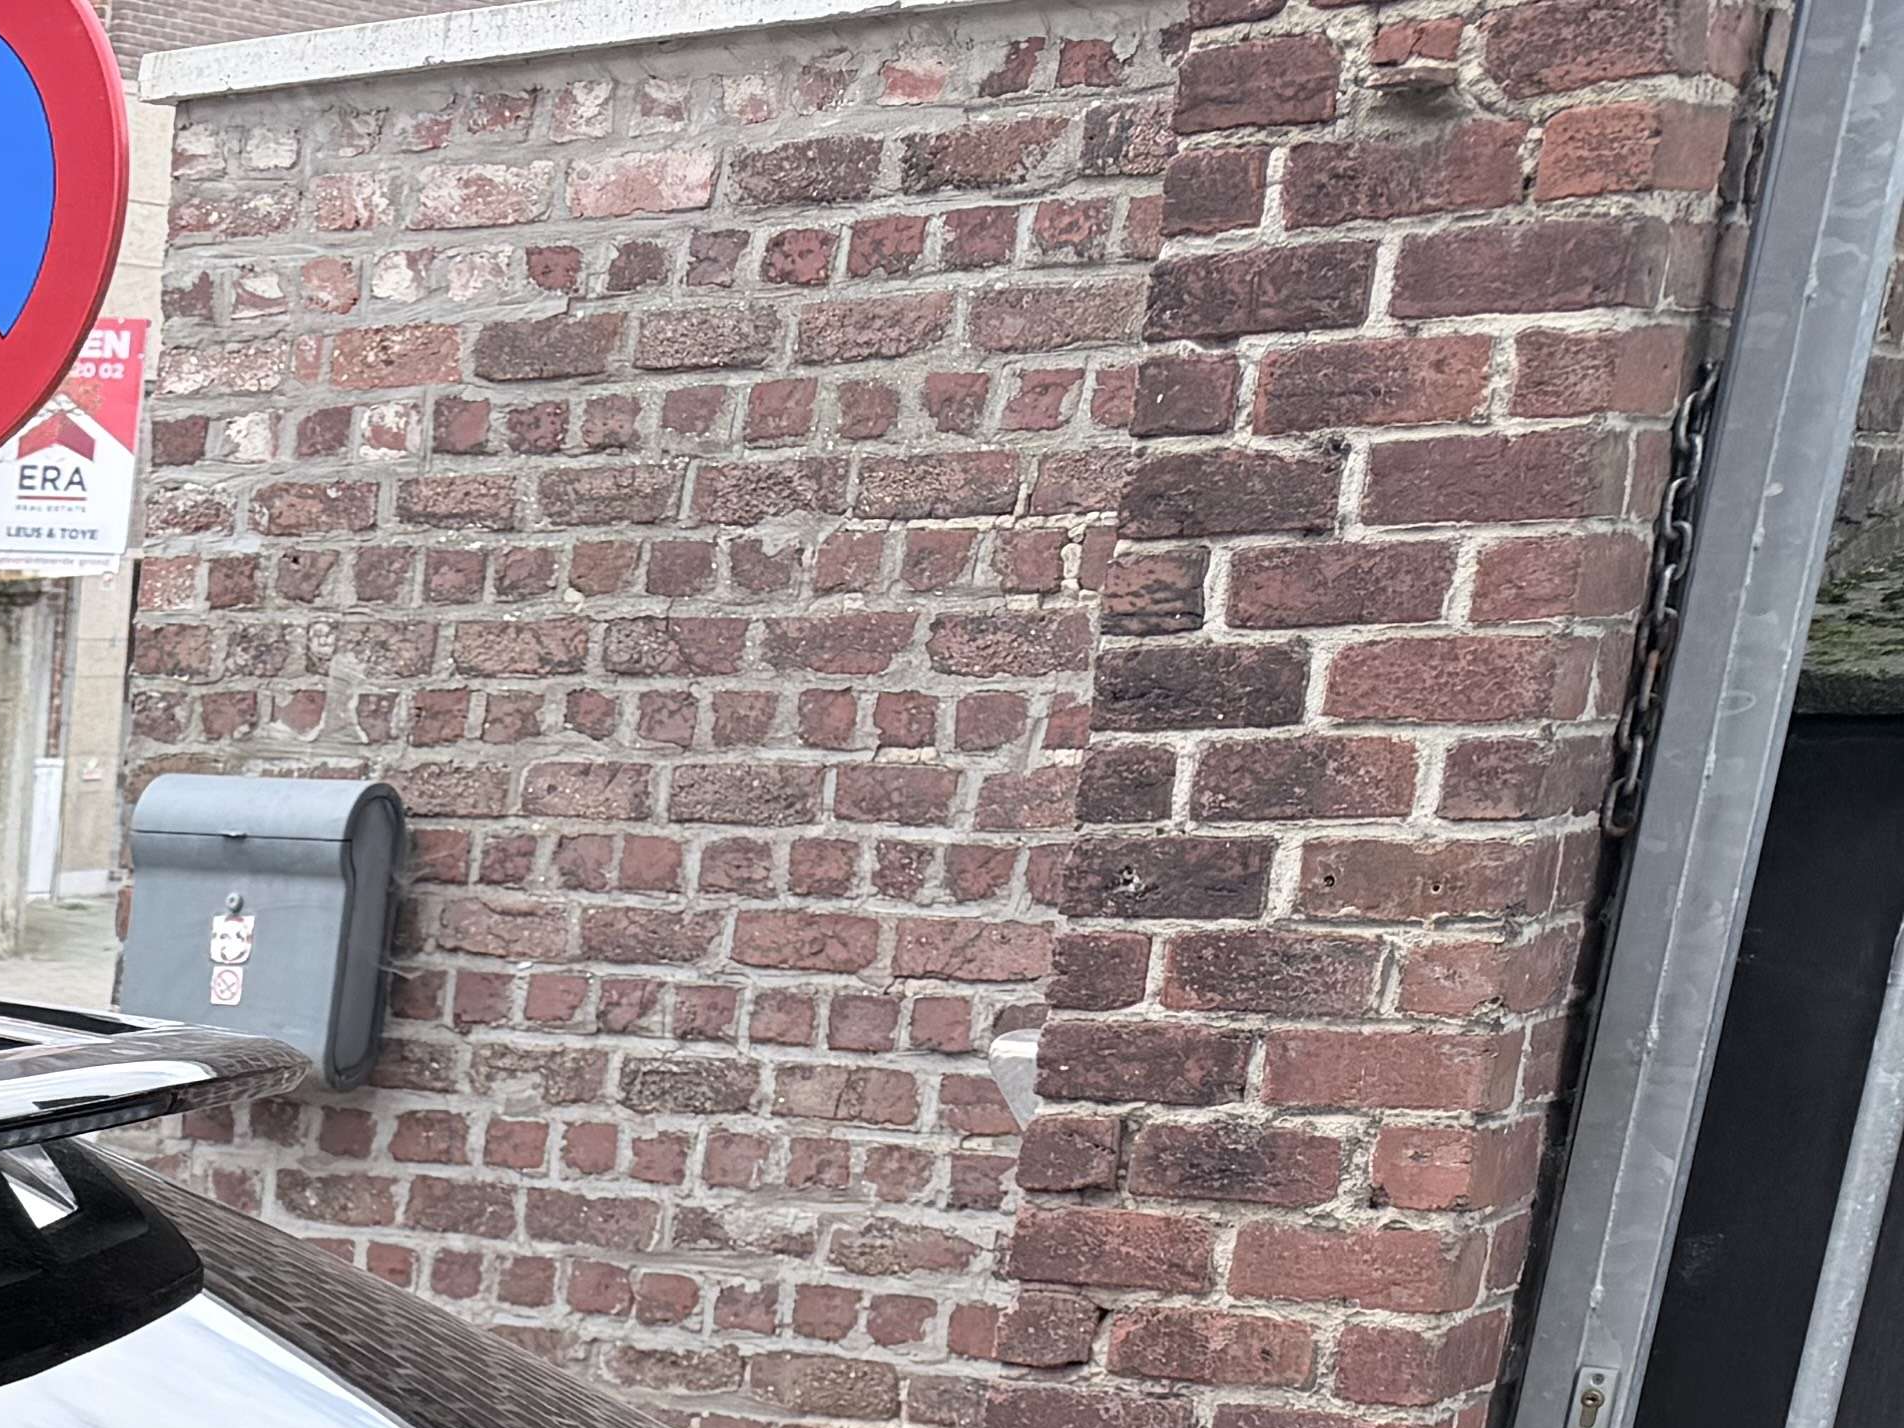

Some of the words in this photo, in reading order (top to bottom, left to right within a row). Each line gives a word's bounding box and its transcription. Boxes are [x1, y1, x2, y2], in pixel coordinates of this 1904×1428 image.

[79, 329, 131, 360] EN
[98, 362, 125, 379] 02
[18, 464, 87, 492] ERA
